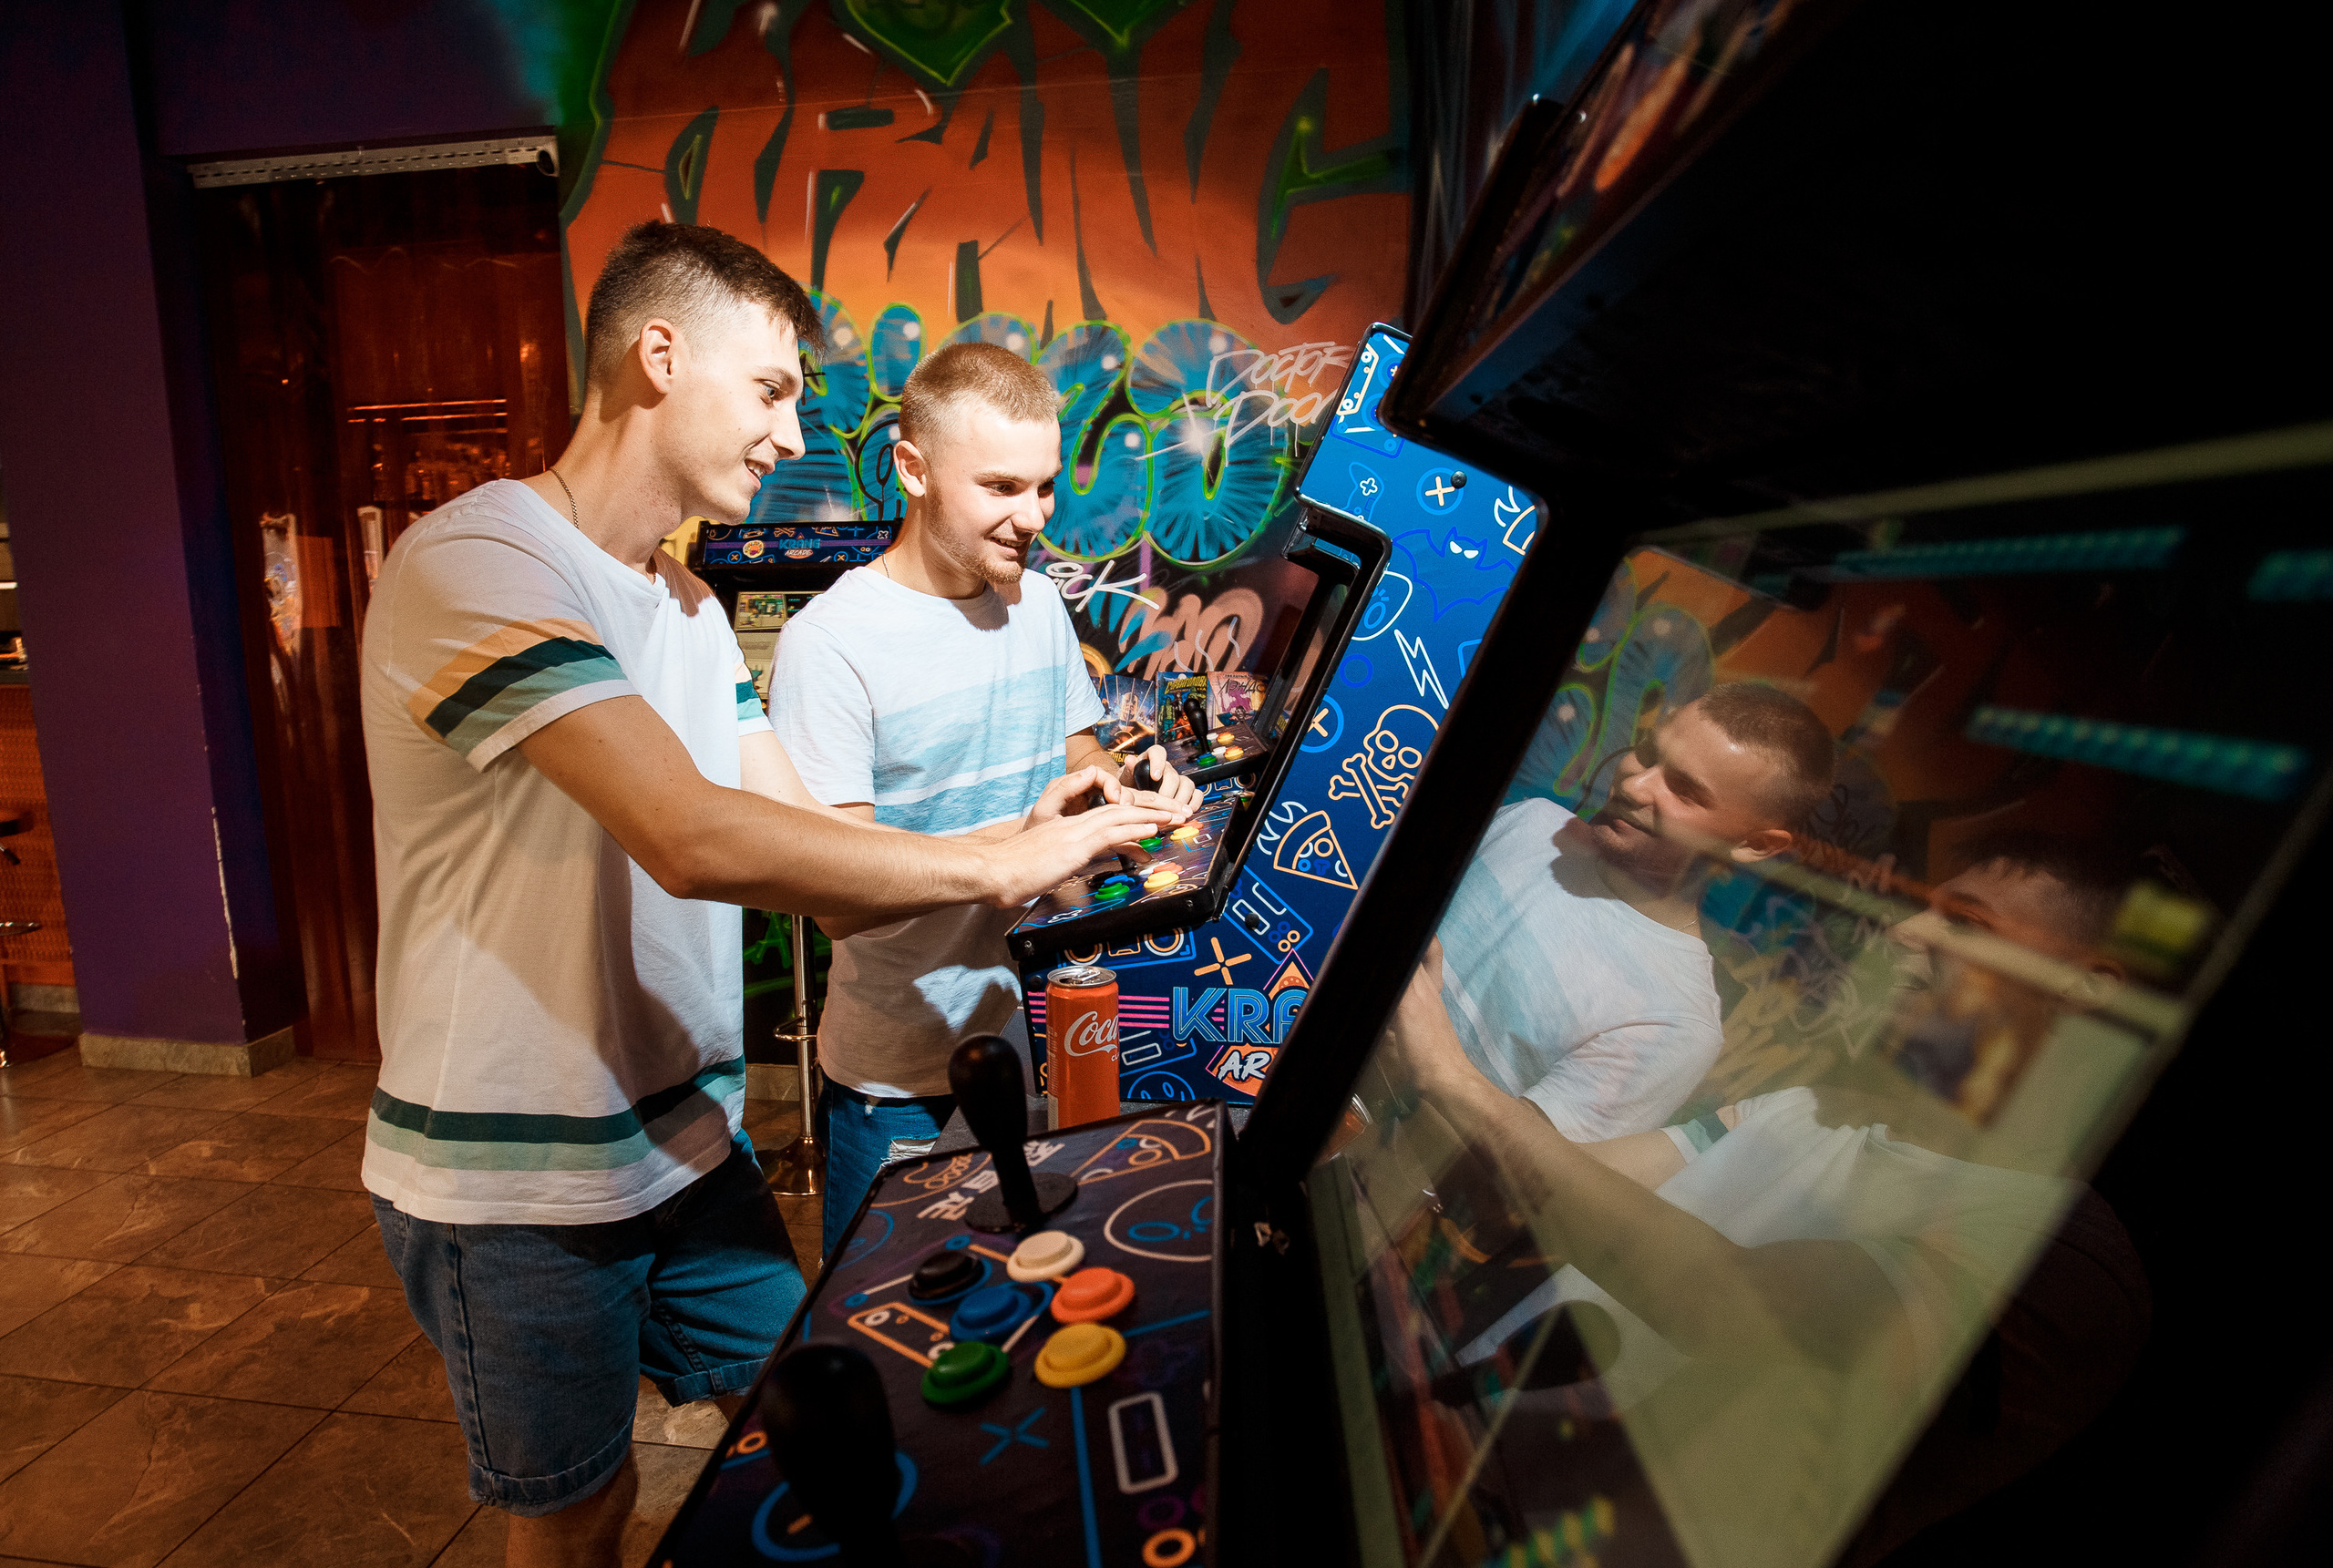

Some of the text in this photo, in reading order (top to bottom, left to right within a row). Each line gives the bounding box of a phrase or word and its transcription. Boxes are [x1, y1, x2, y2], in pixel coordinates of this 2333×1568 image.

[779, 538, 820, 549] KRANG
[1173, 987, 1308, 1044] KRA
[1218, 1050, 1271, 1081] AR
